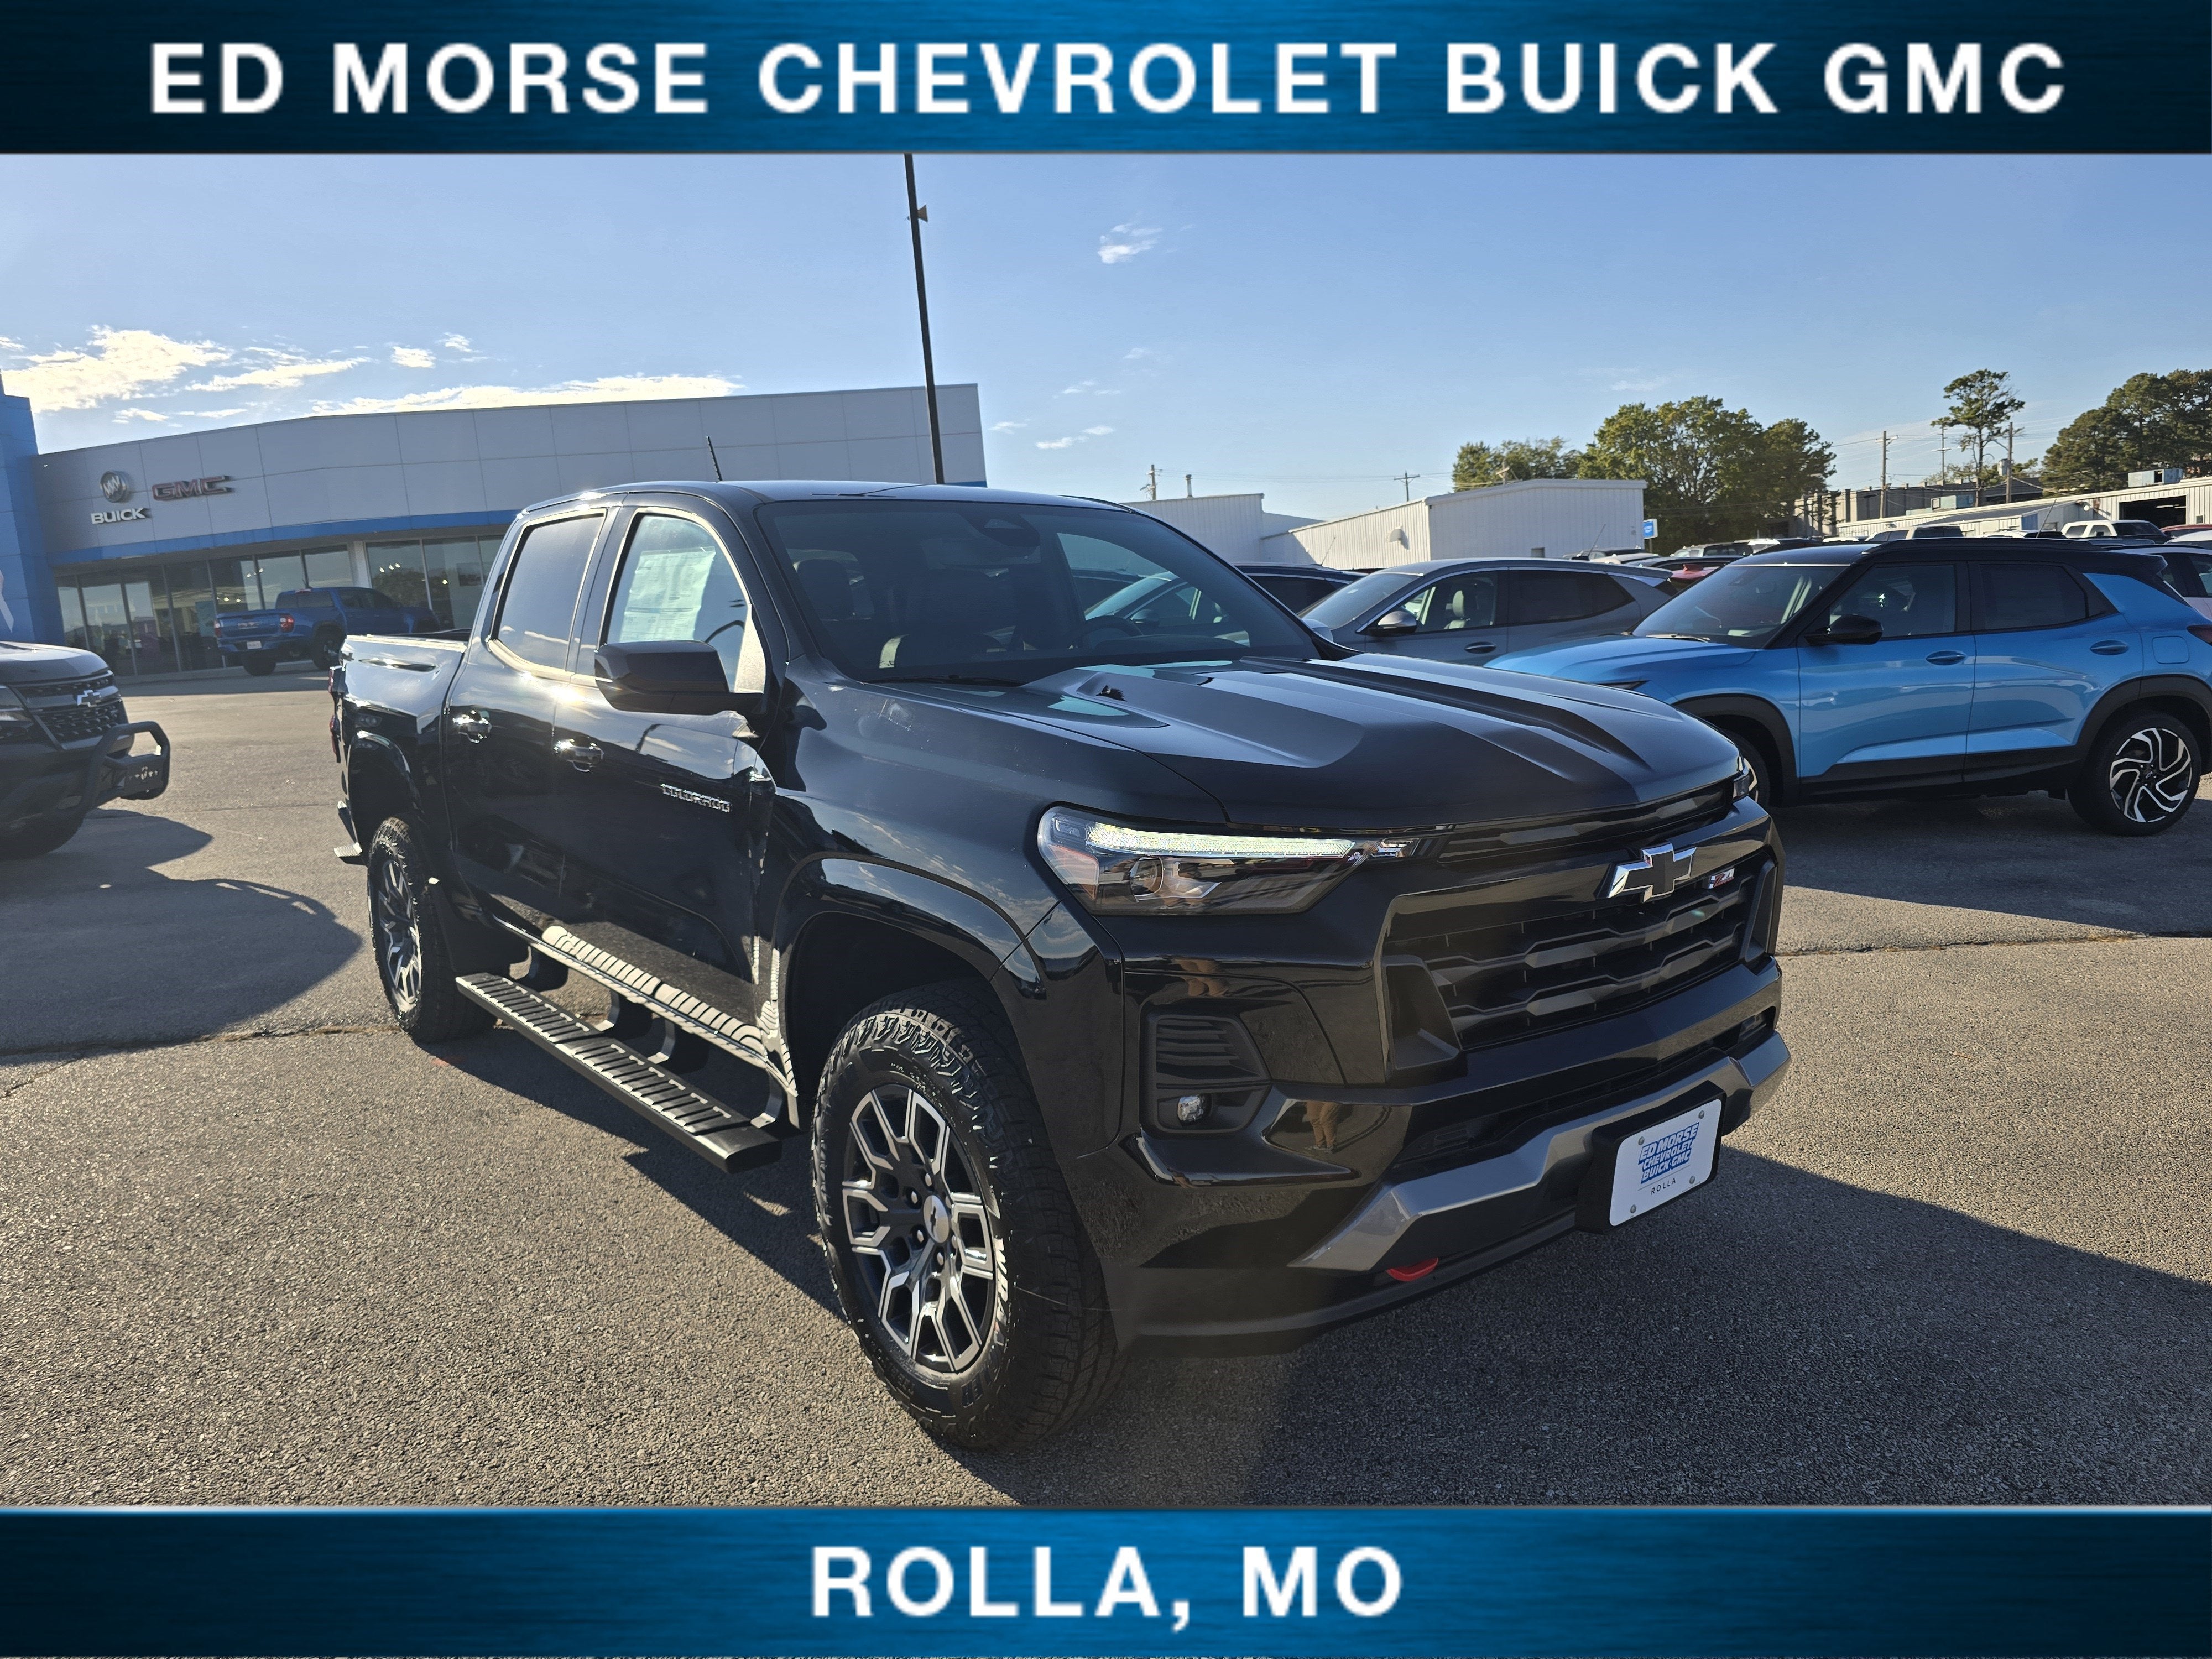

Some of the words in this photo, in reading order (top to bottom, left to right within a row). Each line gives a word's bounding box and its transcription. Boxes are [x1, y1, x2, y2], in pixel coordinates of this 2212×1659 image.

[152, 475, 227, 502] GMC
[91, 507, 146, 524] BUICK
[1639, 1141, 1658, 1162] ED
[1656, 1123, 1699, 1154] MORSE
[1642, 1140, 1693, 1170] CHEVROLET
[1642, 1159, 1670, 1182] BUICK
[1671, 1149, 1691, 1167] GMC
[1651, 1177, 1676, 1195] ROLLA
